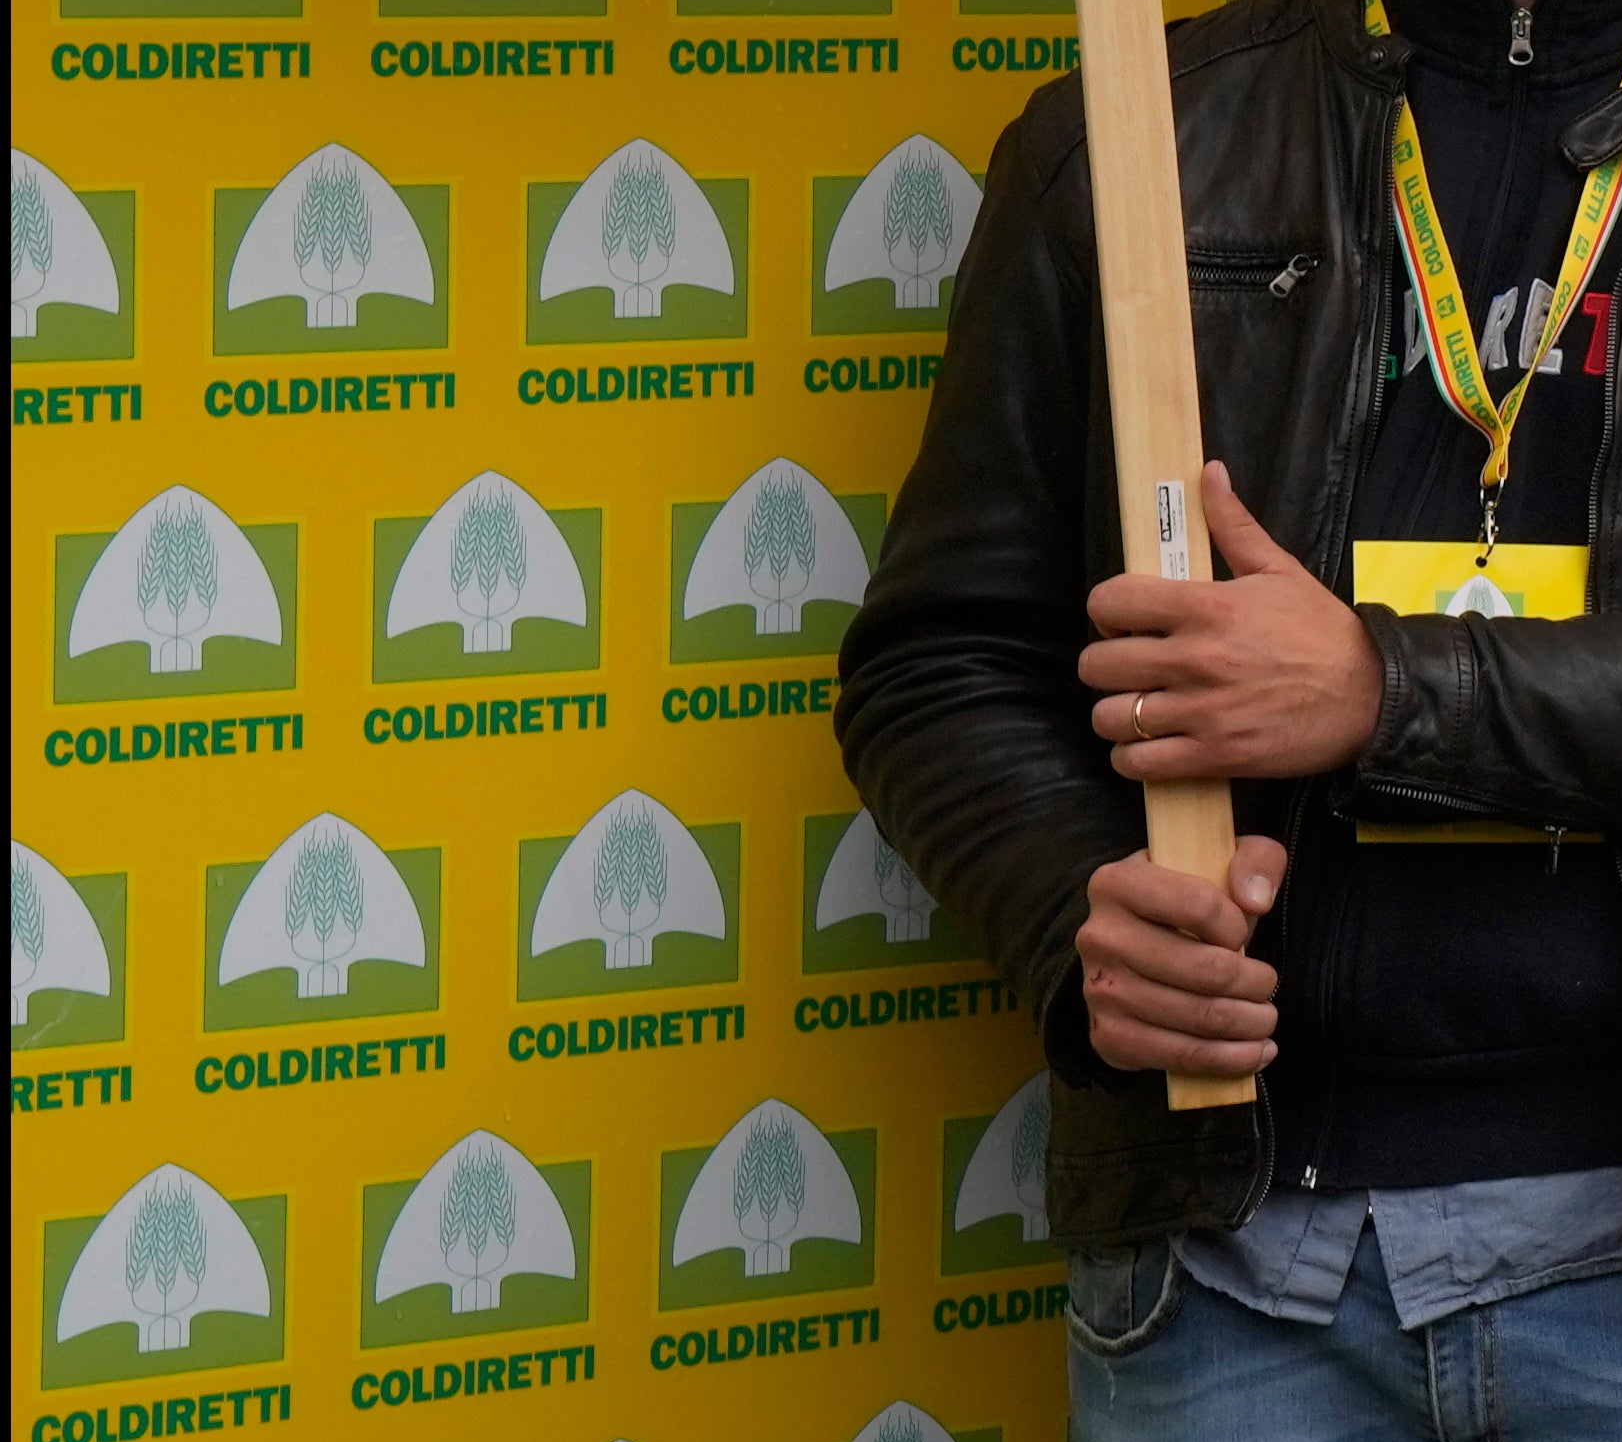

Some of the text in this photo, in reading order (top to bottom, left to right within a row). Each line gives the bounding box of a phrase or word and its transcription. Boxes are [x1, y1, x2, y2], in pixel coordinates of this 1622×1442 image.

[53, 44, 309, 79] COLDIRETTI
[373, 42, 613, 76] COLDIRETTI
[671, 40, 897, 72] COLDIRETTI
[953, 38, 1079, 70] COLDIR
[1403, 173, 1444, 276] COLDIRETTI
[206, 374, 454, 416] COLDIRETTI
[520, 363, 753, 404] COLDIRETTI
[805, 356, 942, 392] COLDIR
[1445, 331, 1498, 431] COLDIRETTI
[365, 695, 606, 743] COLDIRETTI
[663, 679, 831, 722] COLDIRE
[46, 715, 302, 765] COLDIRETTI
[510, 1006, 744, 1060] COLDIRETTI
[196, 1036, 445, 1092] COLDIRETTI
[933, 1284, 1068, 1334] COLDIR
[651, 1311, 878, 1369] COLDIRETTI
[353, 1347, 594, 1408] COLDIRETTI
